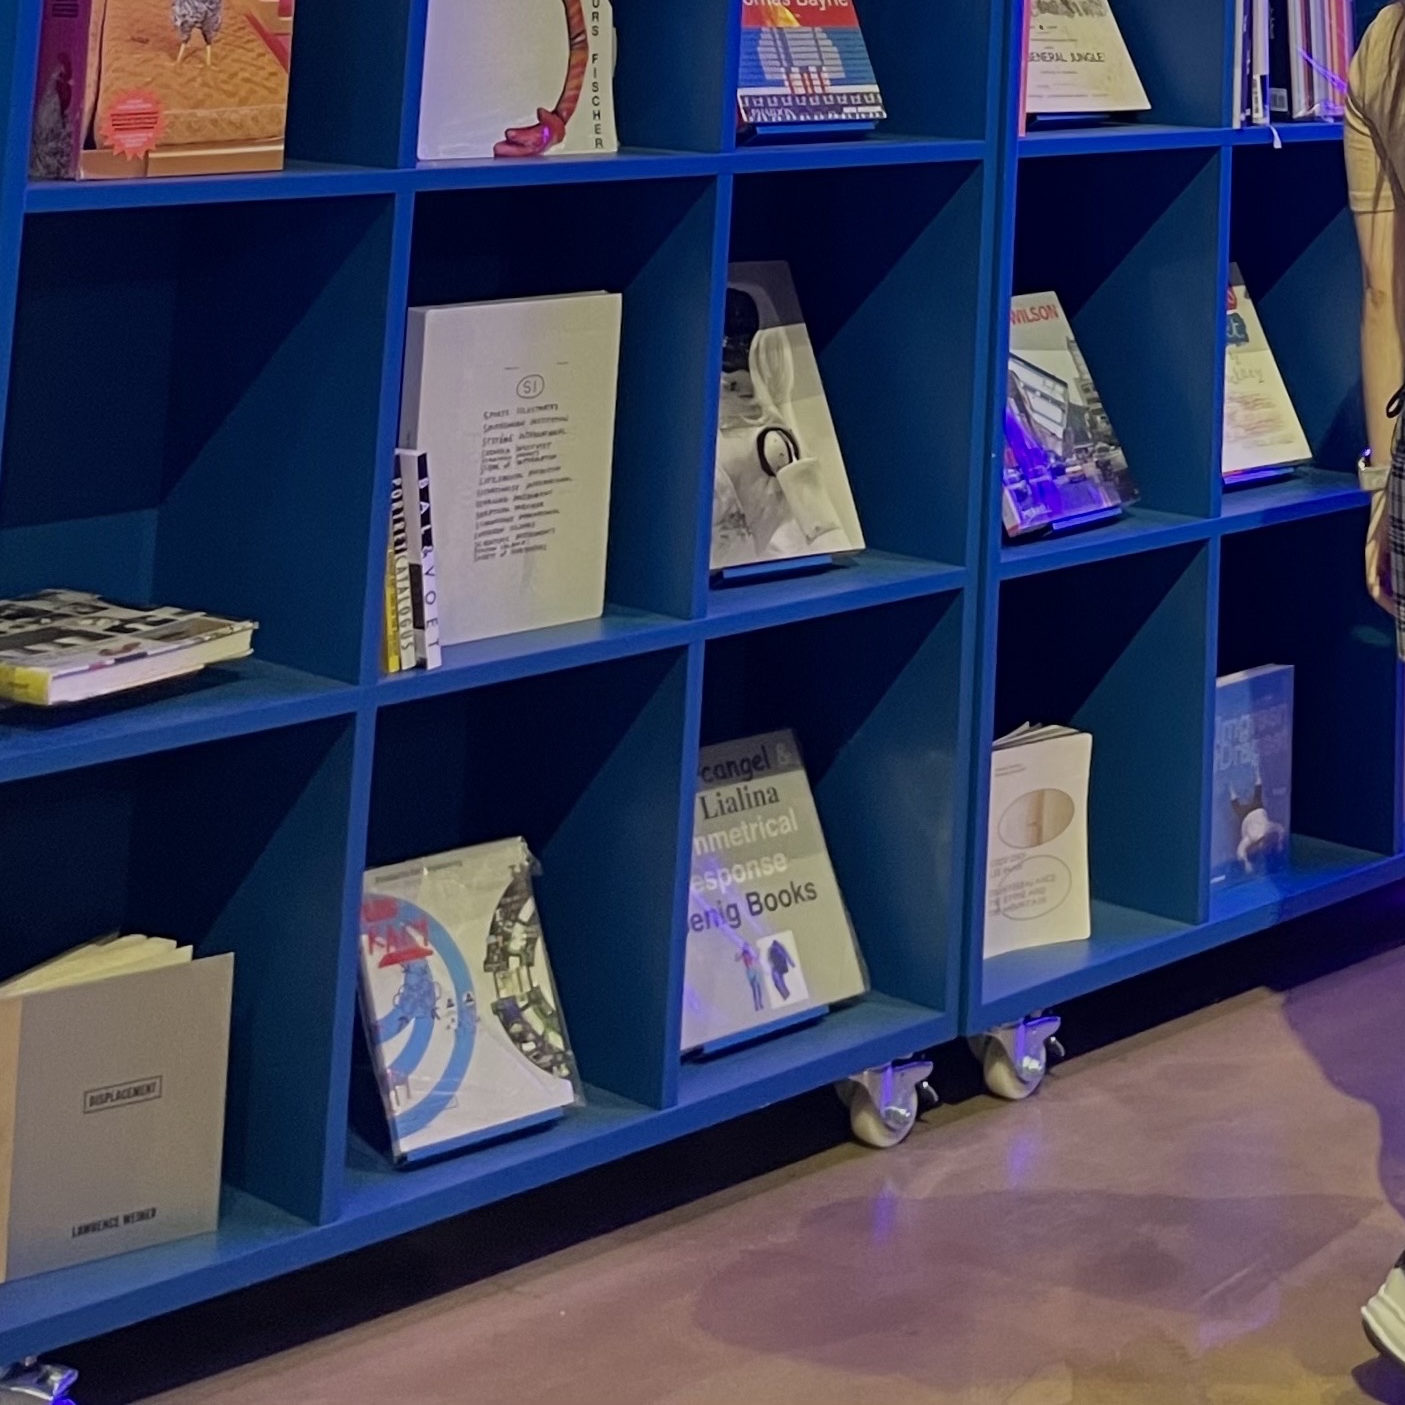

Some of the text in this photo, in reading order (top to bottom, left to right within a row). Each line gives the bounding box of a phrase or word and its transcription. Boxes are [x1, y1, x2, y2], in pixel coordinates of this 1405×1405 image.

[1070, 52, 1104, 63] JUNGLE
[590, 53, 604, 150] FISCHER
[1010, 304, 1059, 325] WILSON
[700, 744, 770, 784] cangel
[700, 786, 780, 821] Lialina
[692, 852, 788, 893] esponse
[690, 881, 818, 933] enig Books
[88, 1081, 157, 1108] DISPLACEMENT
[72, 1207, 157, 1239] LAWRENCE WEINER
